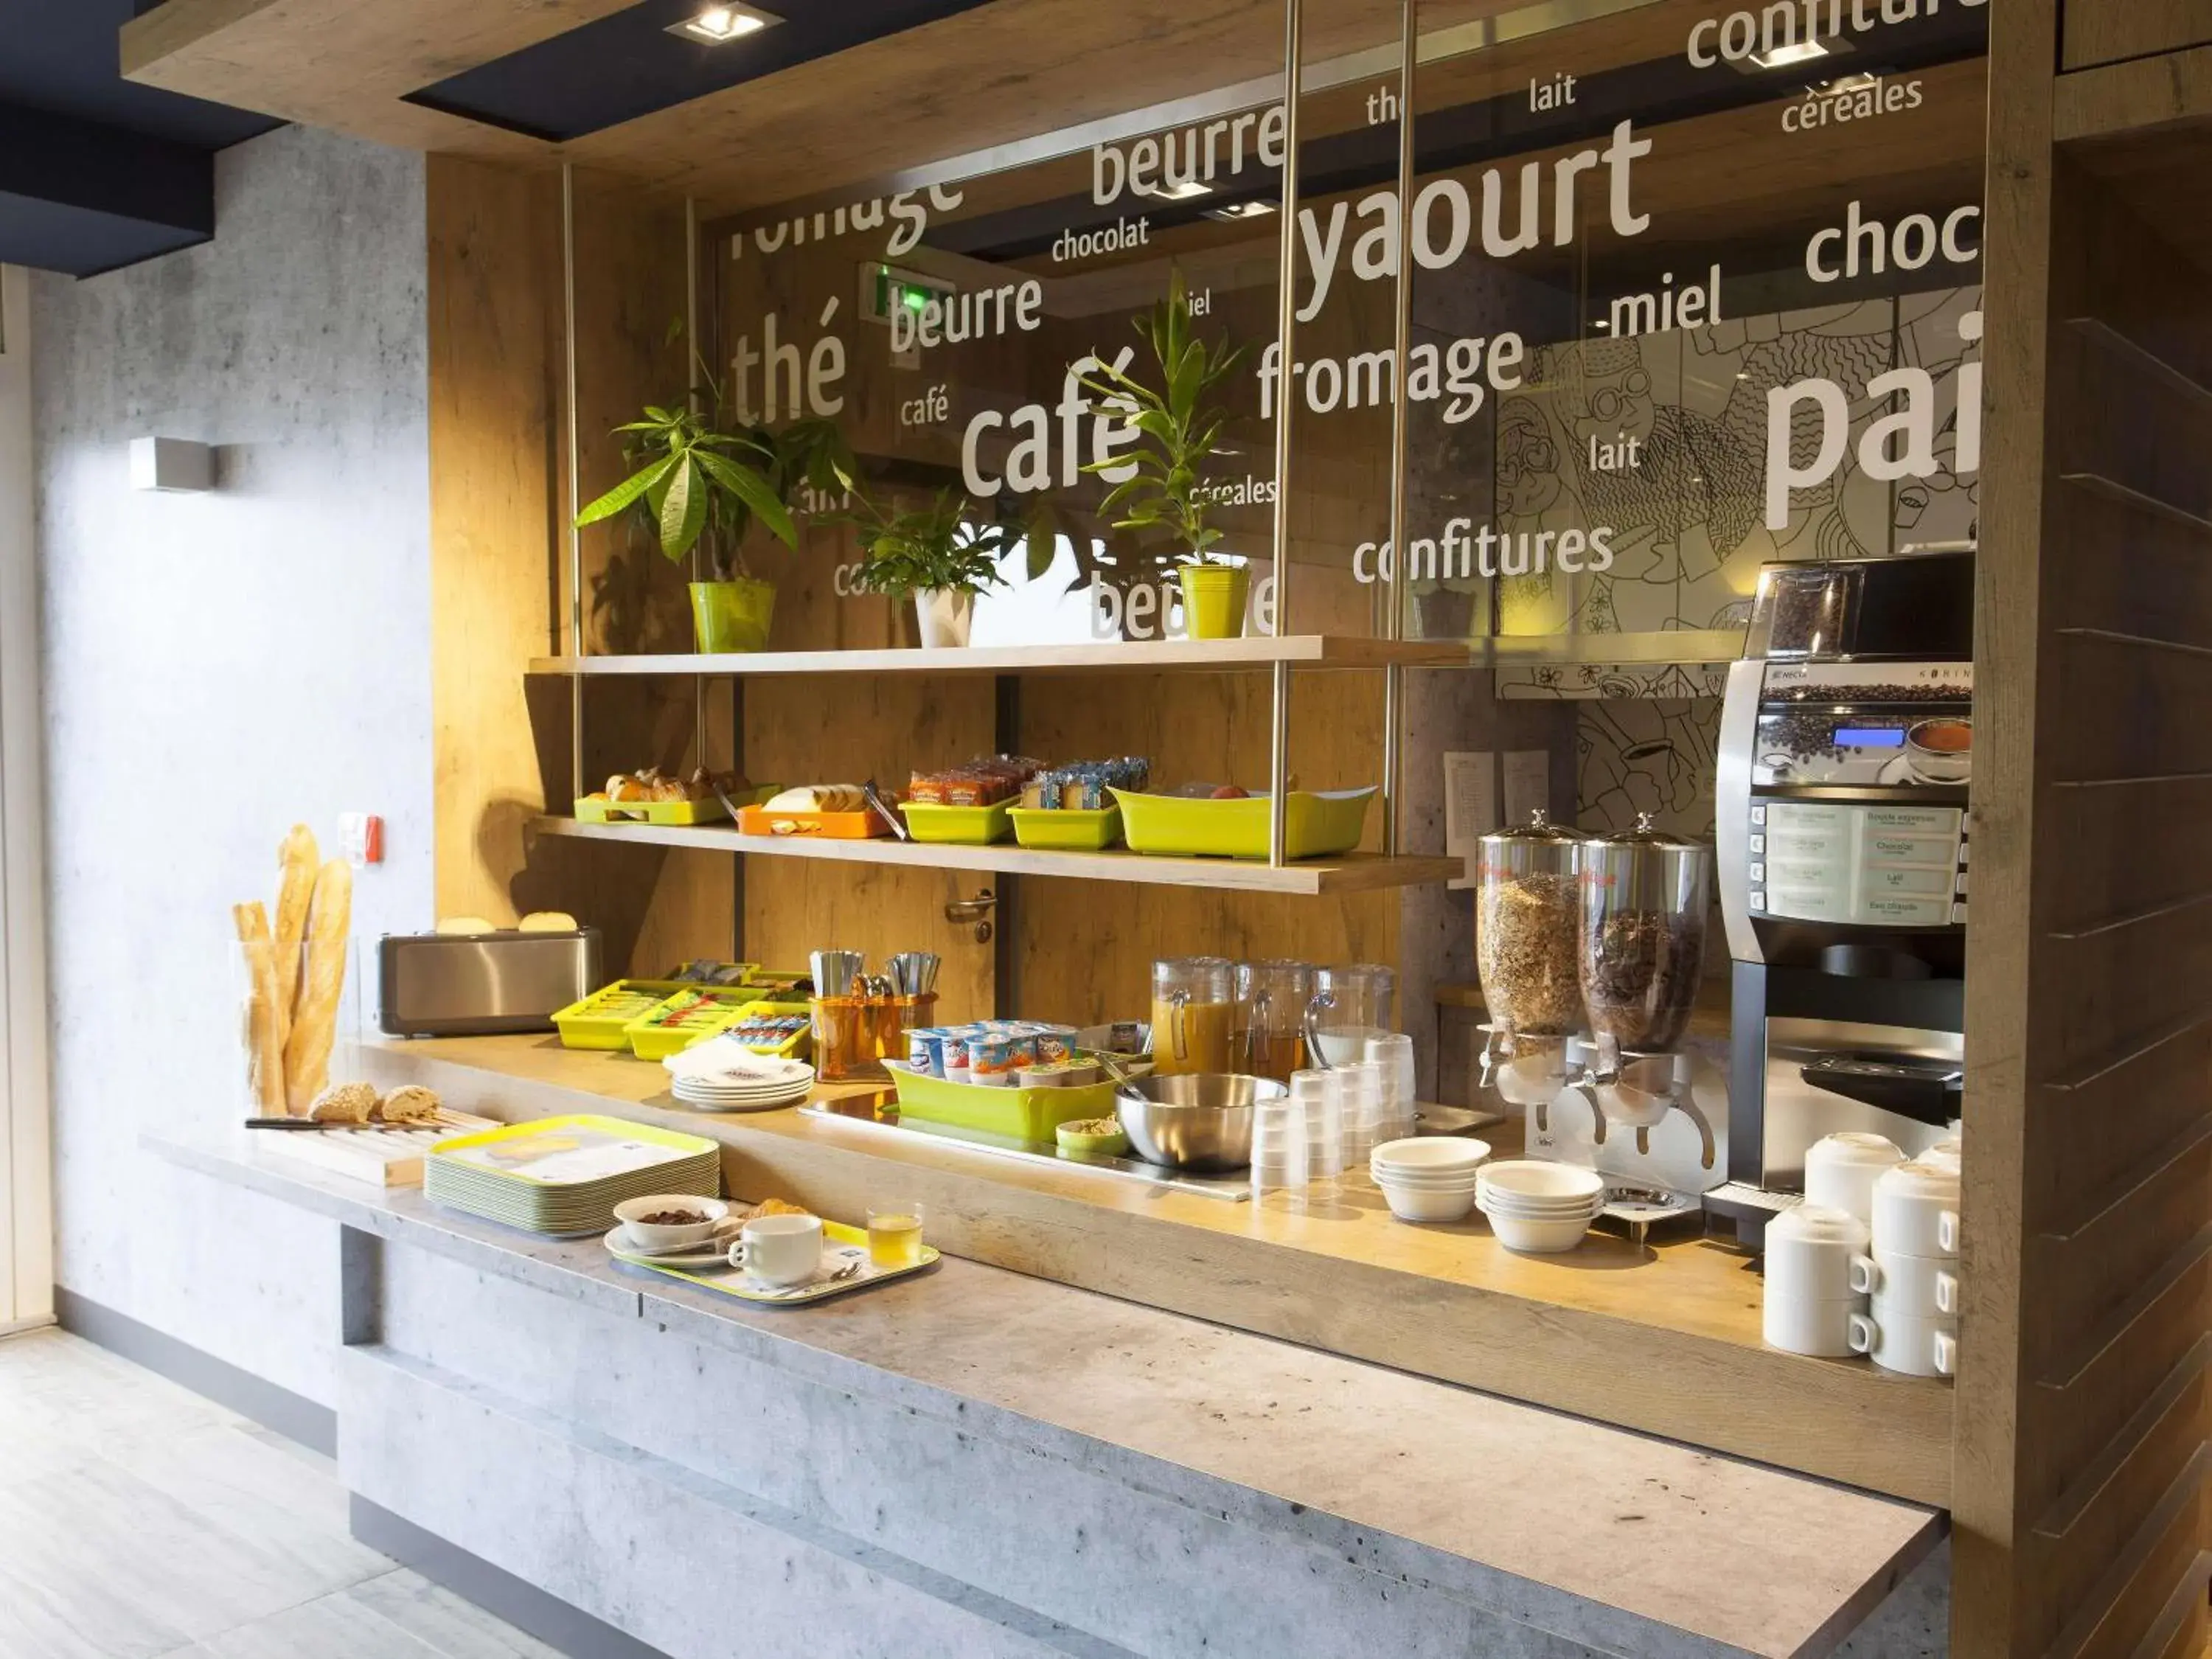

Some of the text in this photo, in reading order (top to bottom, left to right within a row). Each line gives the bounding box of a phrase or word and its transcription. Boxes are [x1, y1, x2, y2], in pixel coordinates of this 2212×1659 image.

[1366, 86, 1402, 125] th
[1530, 72, 1576, 114] lait
[1093, 105, 1284, 206] beurre
[1052, 215, 1150, 262] chocolat
[1295, 119, 1652, 321] yaourt
[1806, 201, 1980, 282] choc
[891, 278, 1041, 353] beurre
[1611, 264, 1721, 339] miel
[732, 296, 846, 426] thé
[1258, 330, 1523, 425] fromage
[901, 383, 948, 426] café
[963, 347, 1141, 497] café
[1766, 310, 1983, 530] pai
[1590, 433, 1641, 472] lait
[1353, 518, 1614, 585] confitures
